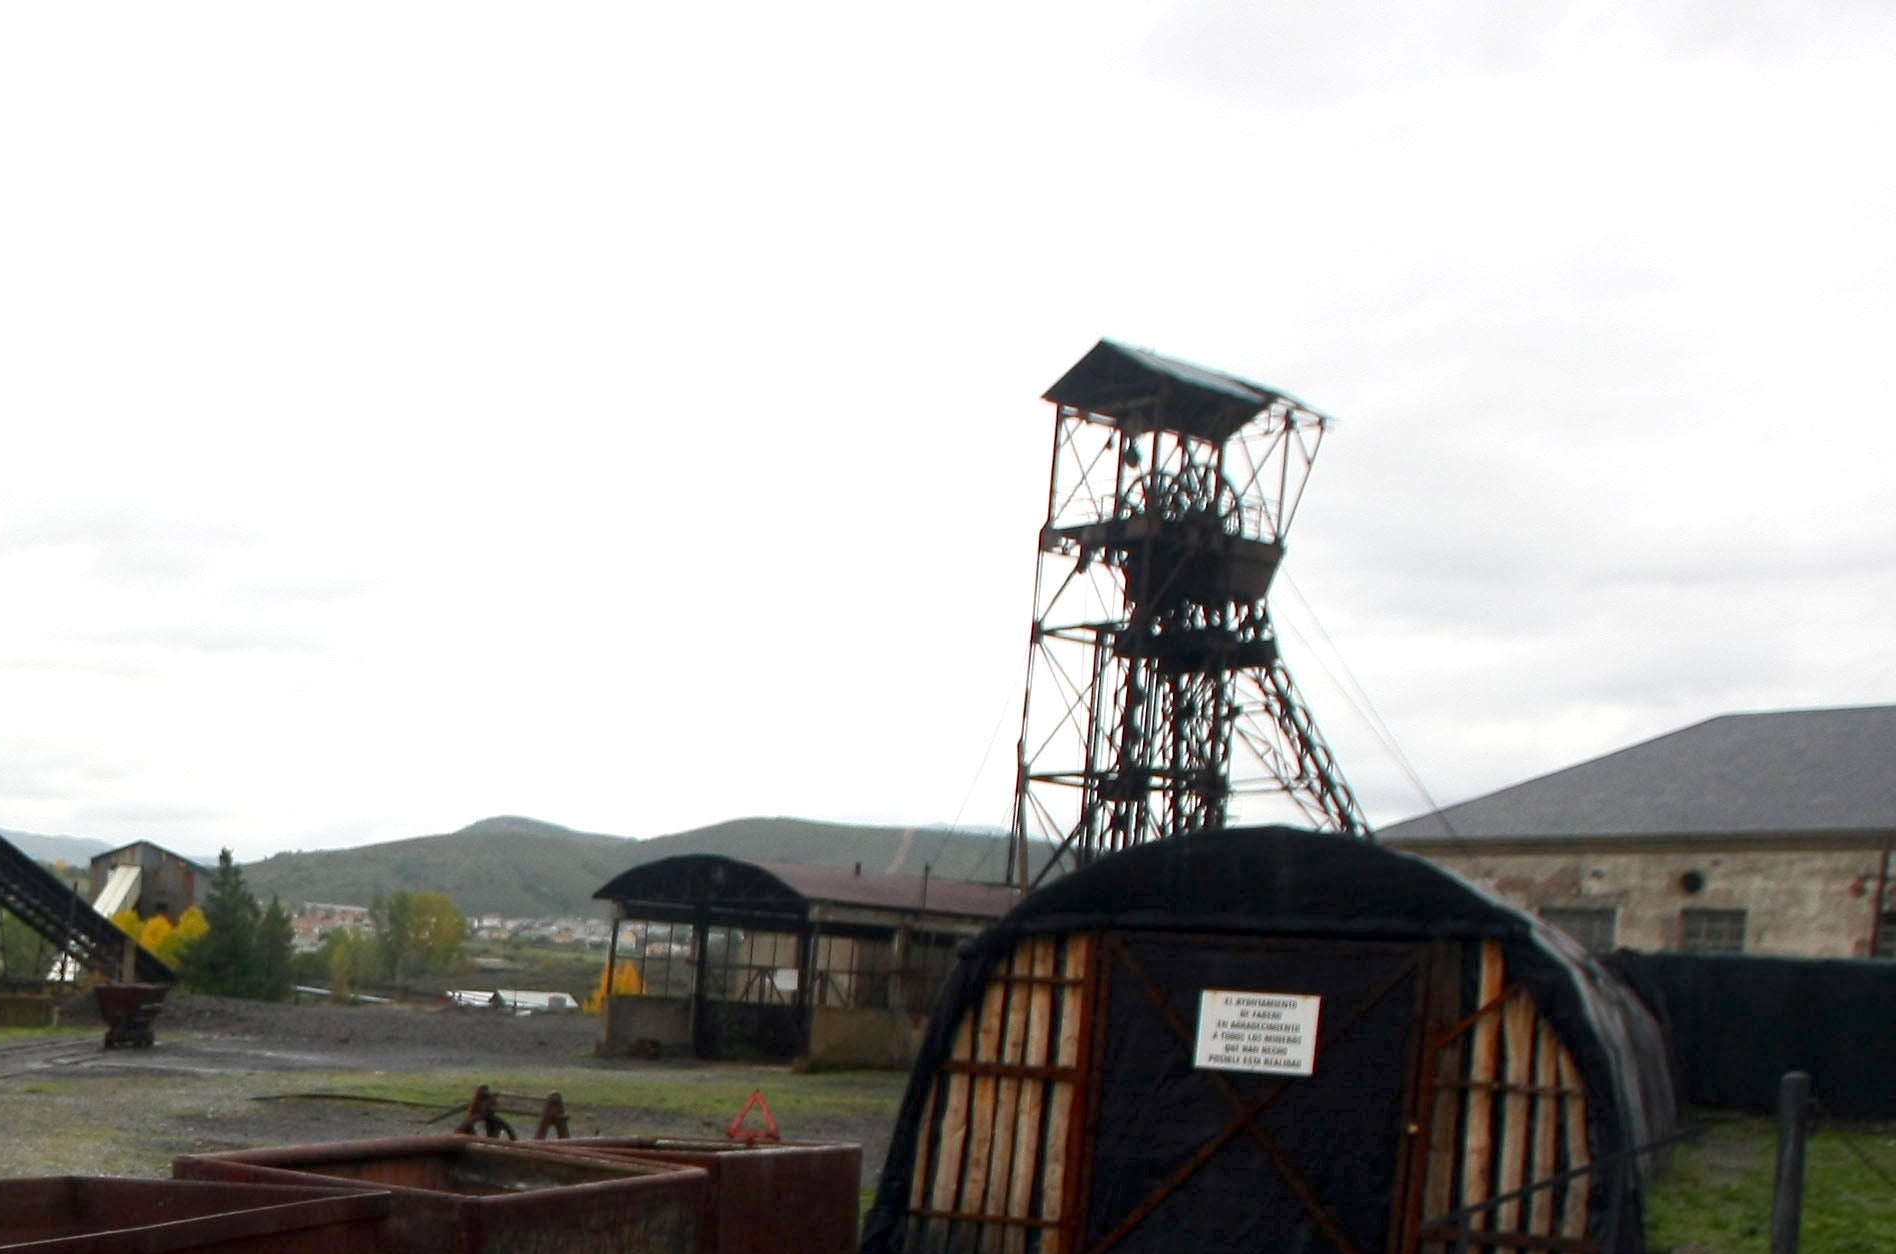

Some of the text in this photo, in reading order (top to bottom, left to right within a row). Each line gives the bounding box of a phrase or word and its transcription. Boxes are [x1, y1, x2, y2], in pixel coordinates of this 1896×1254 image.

[1236, 997, 1298, 1009] AYUNTAMIENTO
[1230, 1020, 1301, 1032] AGRADECIMIENTO
[1264, 1034, 1302, 1044] MINEROS
